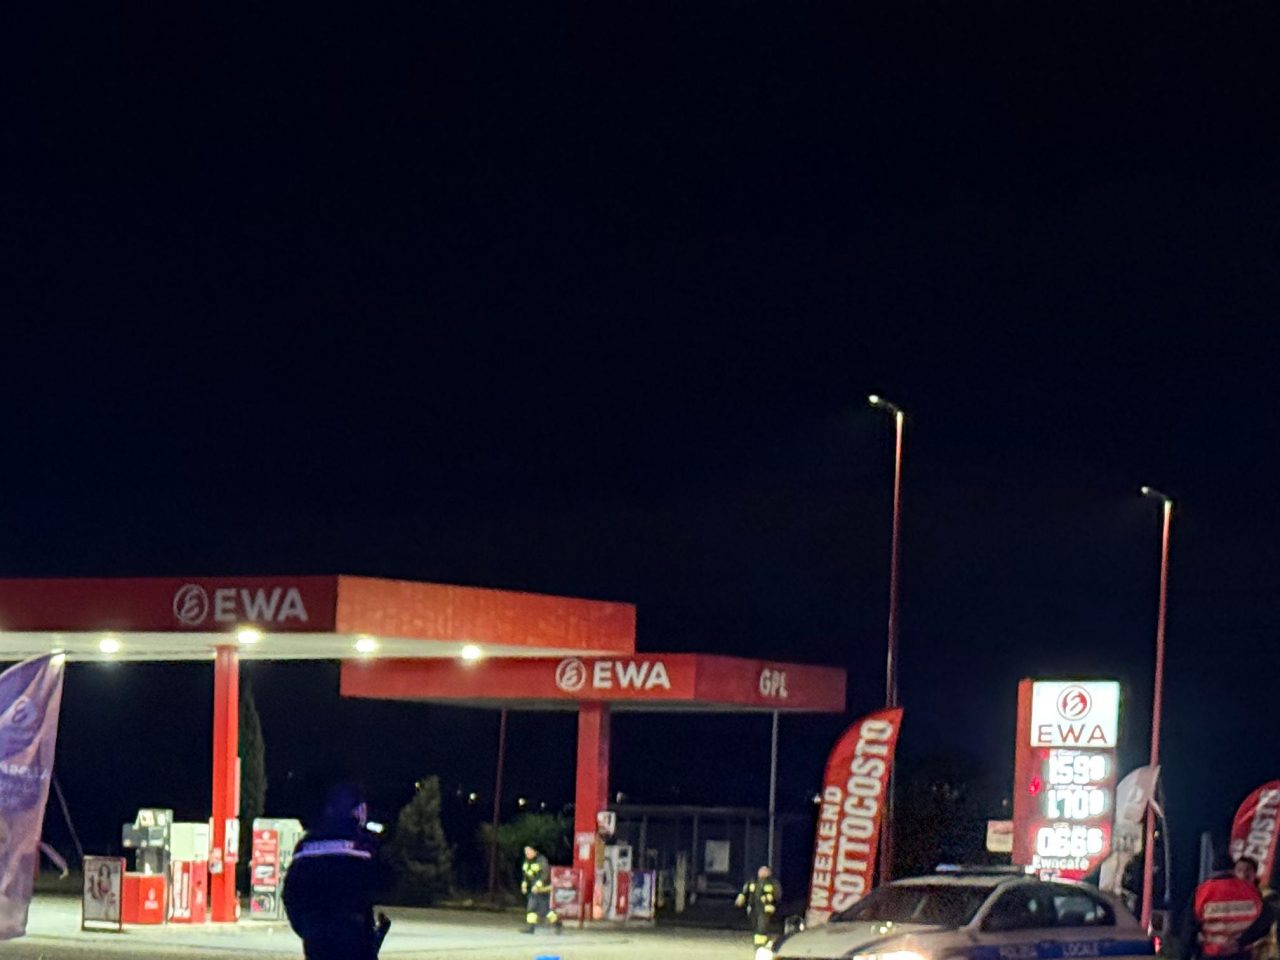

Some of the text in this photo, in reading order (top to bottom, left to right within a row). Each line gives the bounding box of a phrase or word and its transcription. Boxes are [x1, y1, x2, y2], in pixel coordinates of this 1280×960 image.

[214, 587, 309, 623] EWA
[593, 660, 671, 690] EWA
[760, 668, 789, 699] GPL
[1037, 723, 1108, 744] EWA
[831, 719, 894, 913] SOTTOCOSTO
[809, 785, 843, 908] WEEKEND
[1062, 942, 1100, 957] LOCALE
